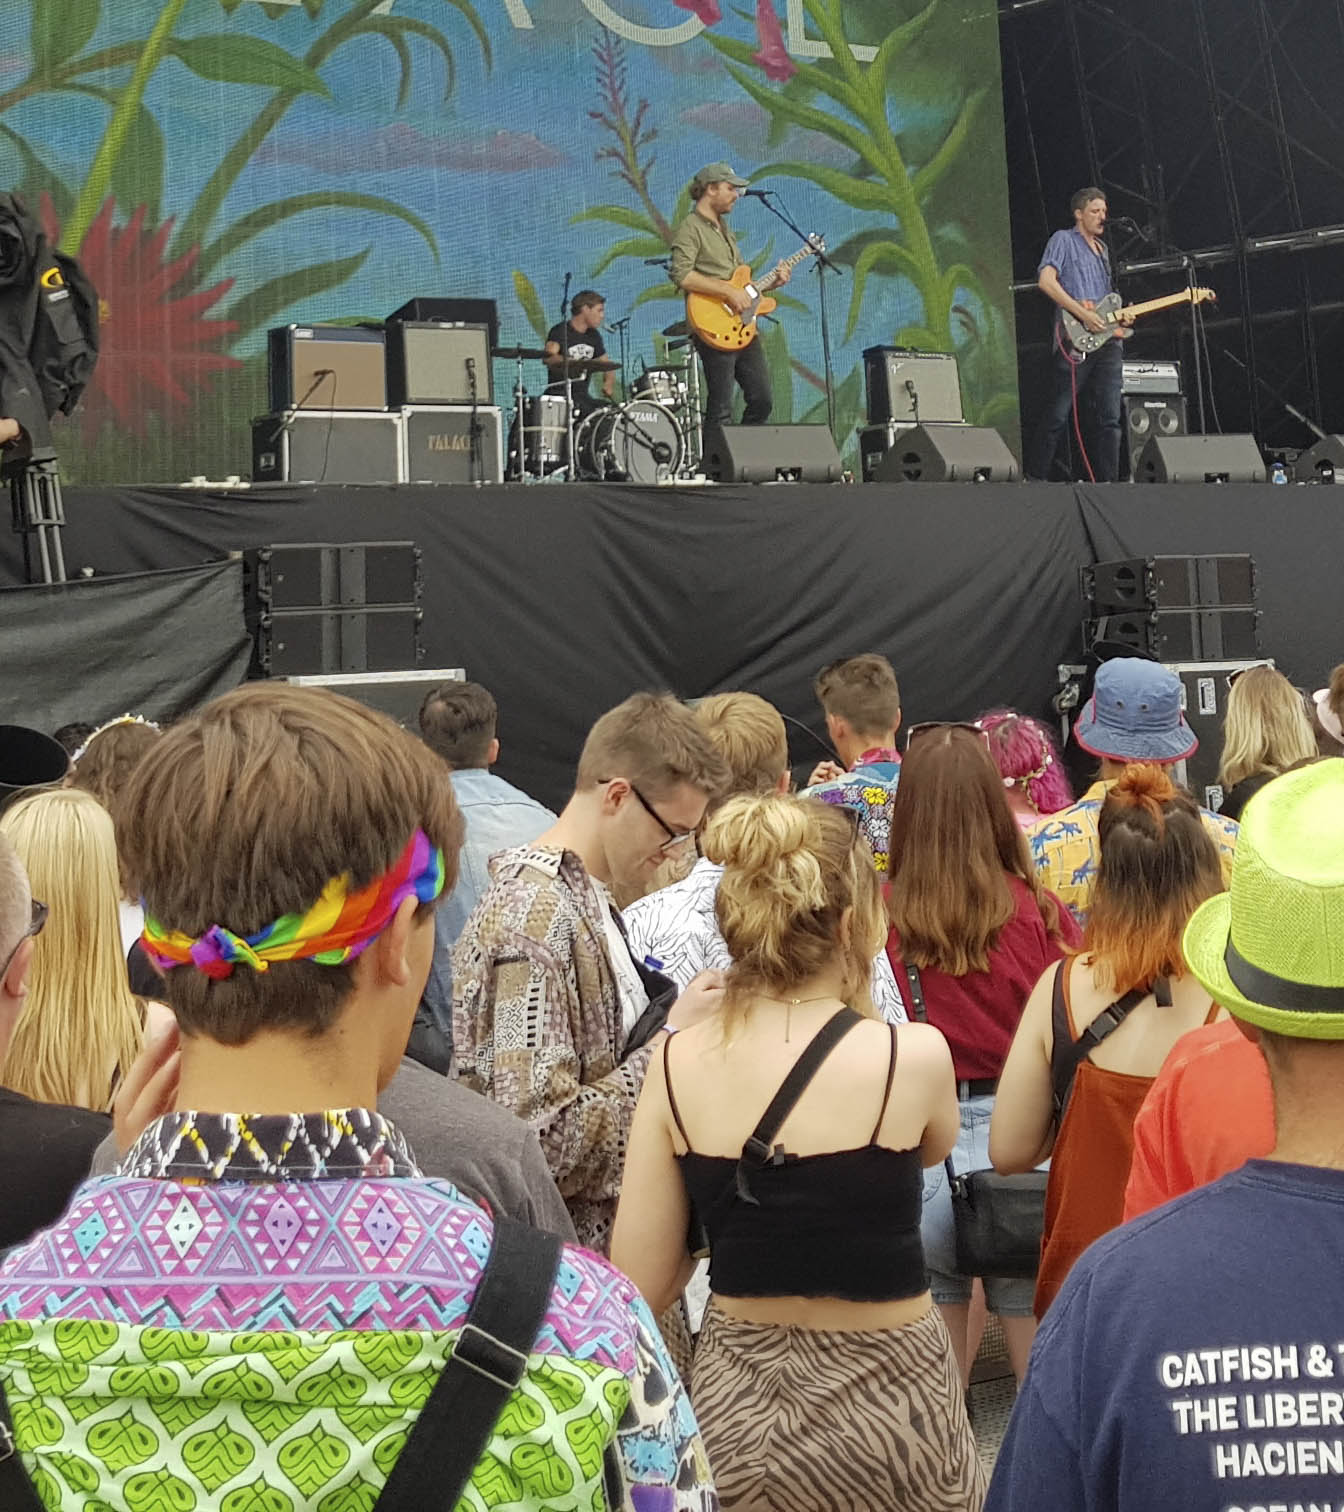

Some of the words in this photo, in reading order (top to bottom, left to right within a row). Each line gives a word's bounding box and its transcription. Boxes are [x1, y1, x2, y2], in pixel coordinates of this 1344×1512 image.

[1162, 1346, 1299, 1388] CATFISH
[1307, 1345, 1334, 1377] &
[1172, 1396, 1239, 1434] THE
